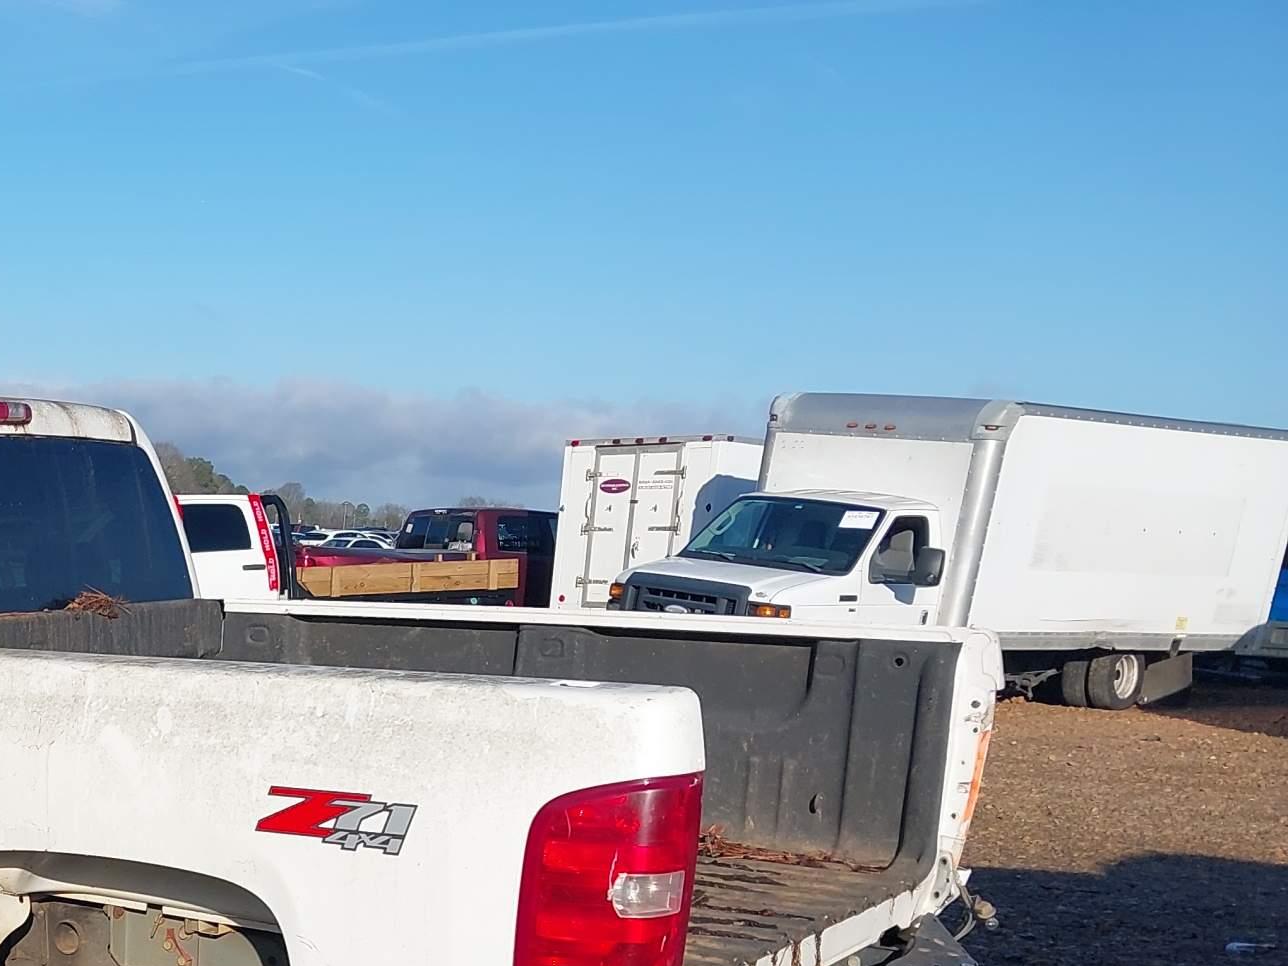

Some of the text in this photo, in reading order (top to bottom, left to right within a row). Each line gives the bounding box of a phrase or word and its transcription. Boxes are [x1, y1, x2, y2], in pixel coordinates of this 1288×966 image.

[252, 500, 264, 522] HOLD
[260, 529, 271, 551] HOLD
[254, 785, 418, 838] Z71
